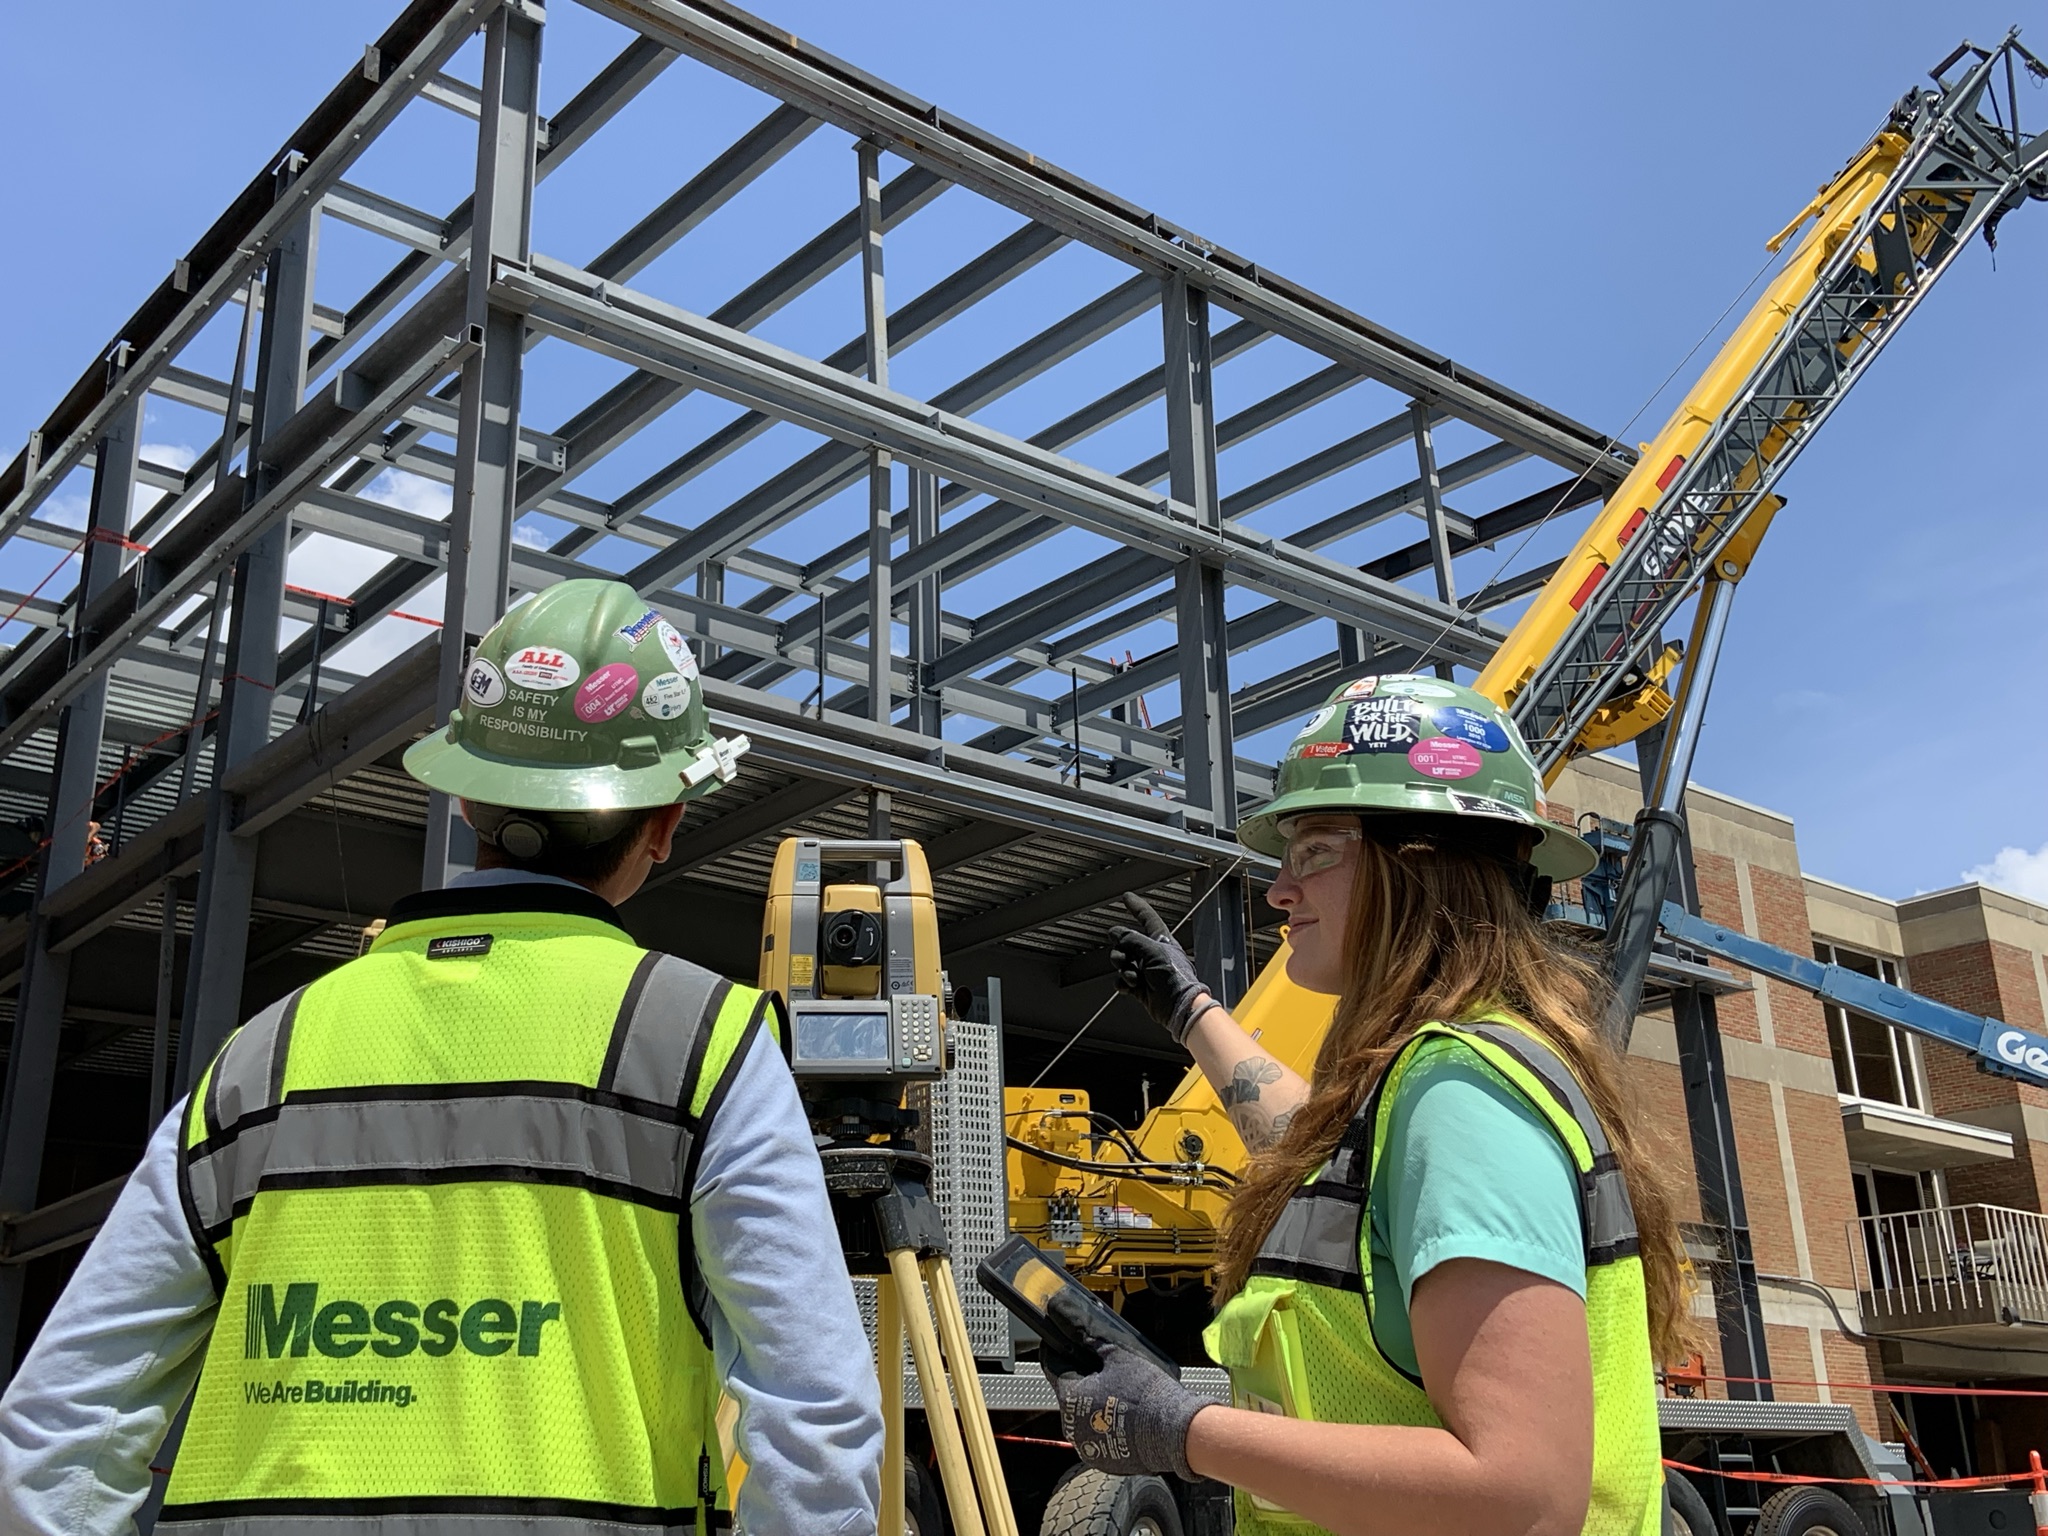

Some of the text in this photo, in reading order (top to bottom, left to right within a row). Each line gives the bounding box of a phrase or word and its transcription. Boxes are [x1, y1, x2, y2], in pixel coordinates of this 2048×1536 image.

[1640, 487, 1710, 577] GROVE
[519, 651, 565, 668] ALL
[584, 670, 611, 693] Messer
[655, 675, 679, 688] Messer
[508, 689, 560, 707] SAFETY
[1350, 695, 1414, 714] BUILT
[512, 705, 548, 721] IS MY
[585, 700, 602, 714] 004
[1351, 712, 1411, 724] FOR THE
[479, 714, 588, 742] RESPONSIBILITY
[1349, 722, 1414, 744] WILD.
[1463, 723, 1486, 737] 1000
[1315, 744, 1337, 753] Voted
[1429, 741, 1461, 749] Messer
[1417, 754, 1434, 763] 001
[1504, 791, 1526, 805] MSA
[245, 1282, 562, 1360] Messer
